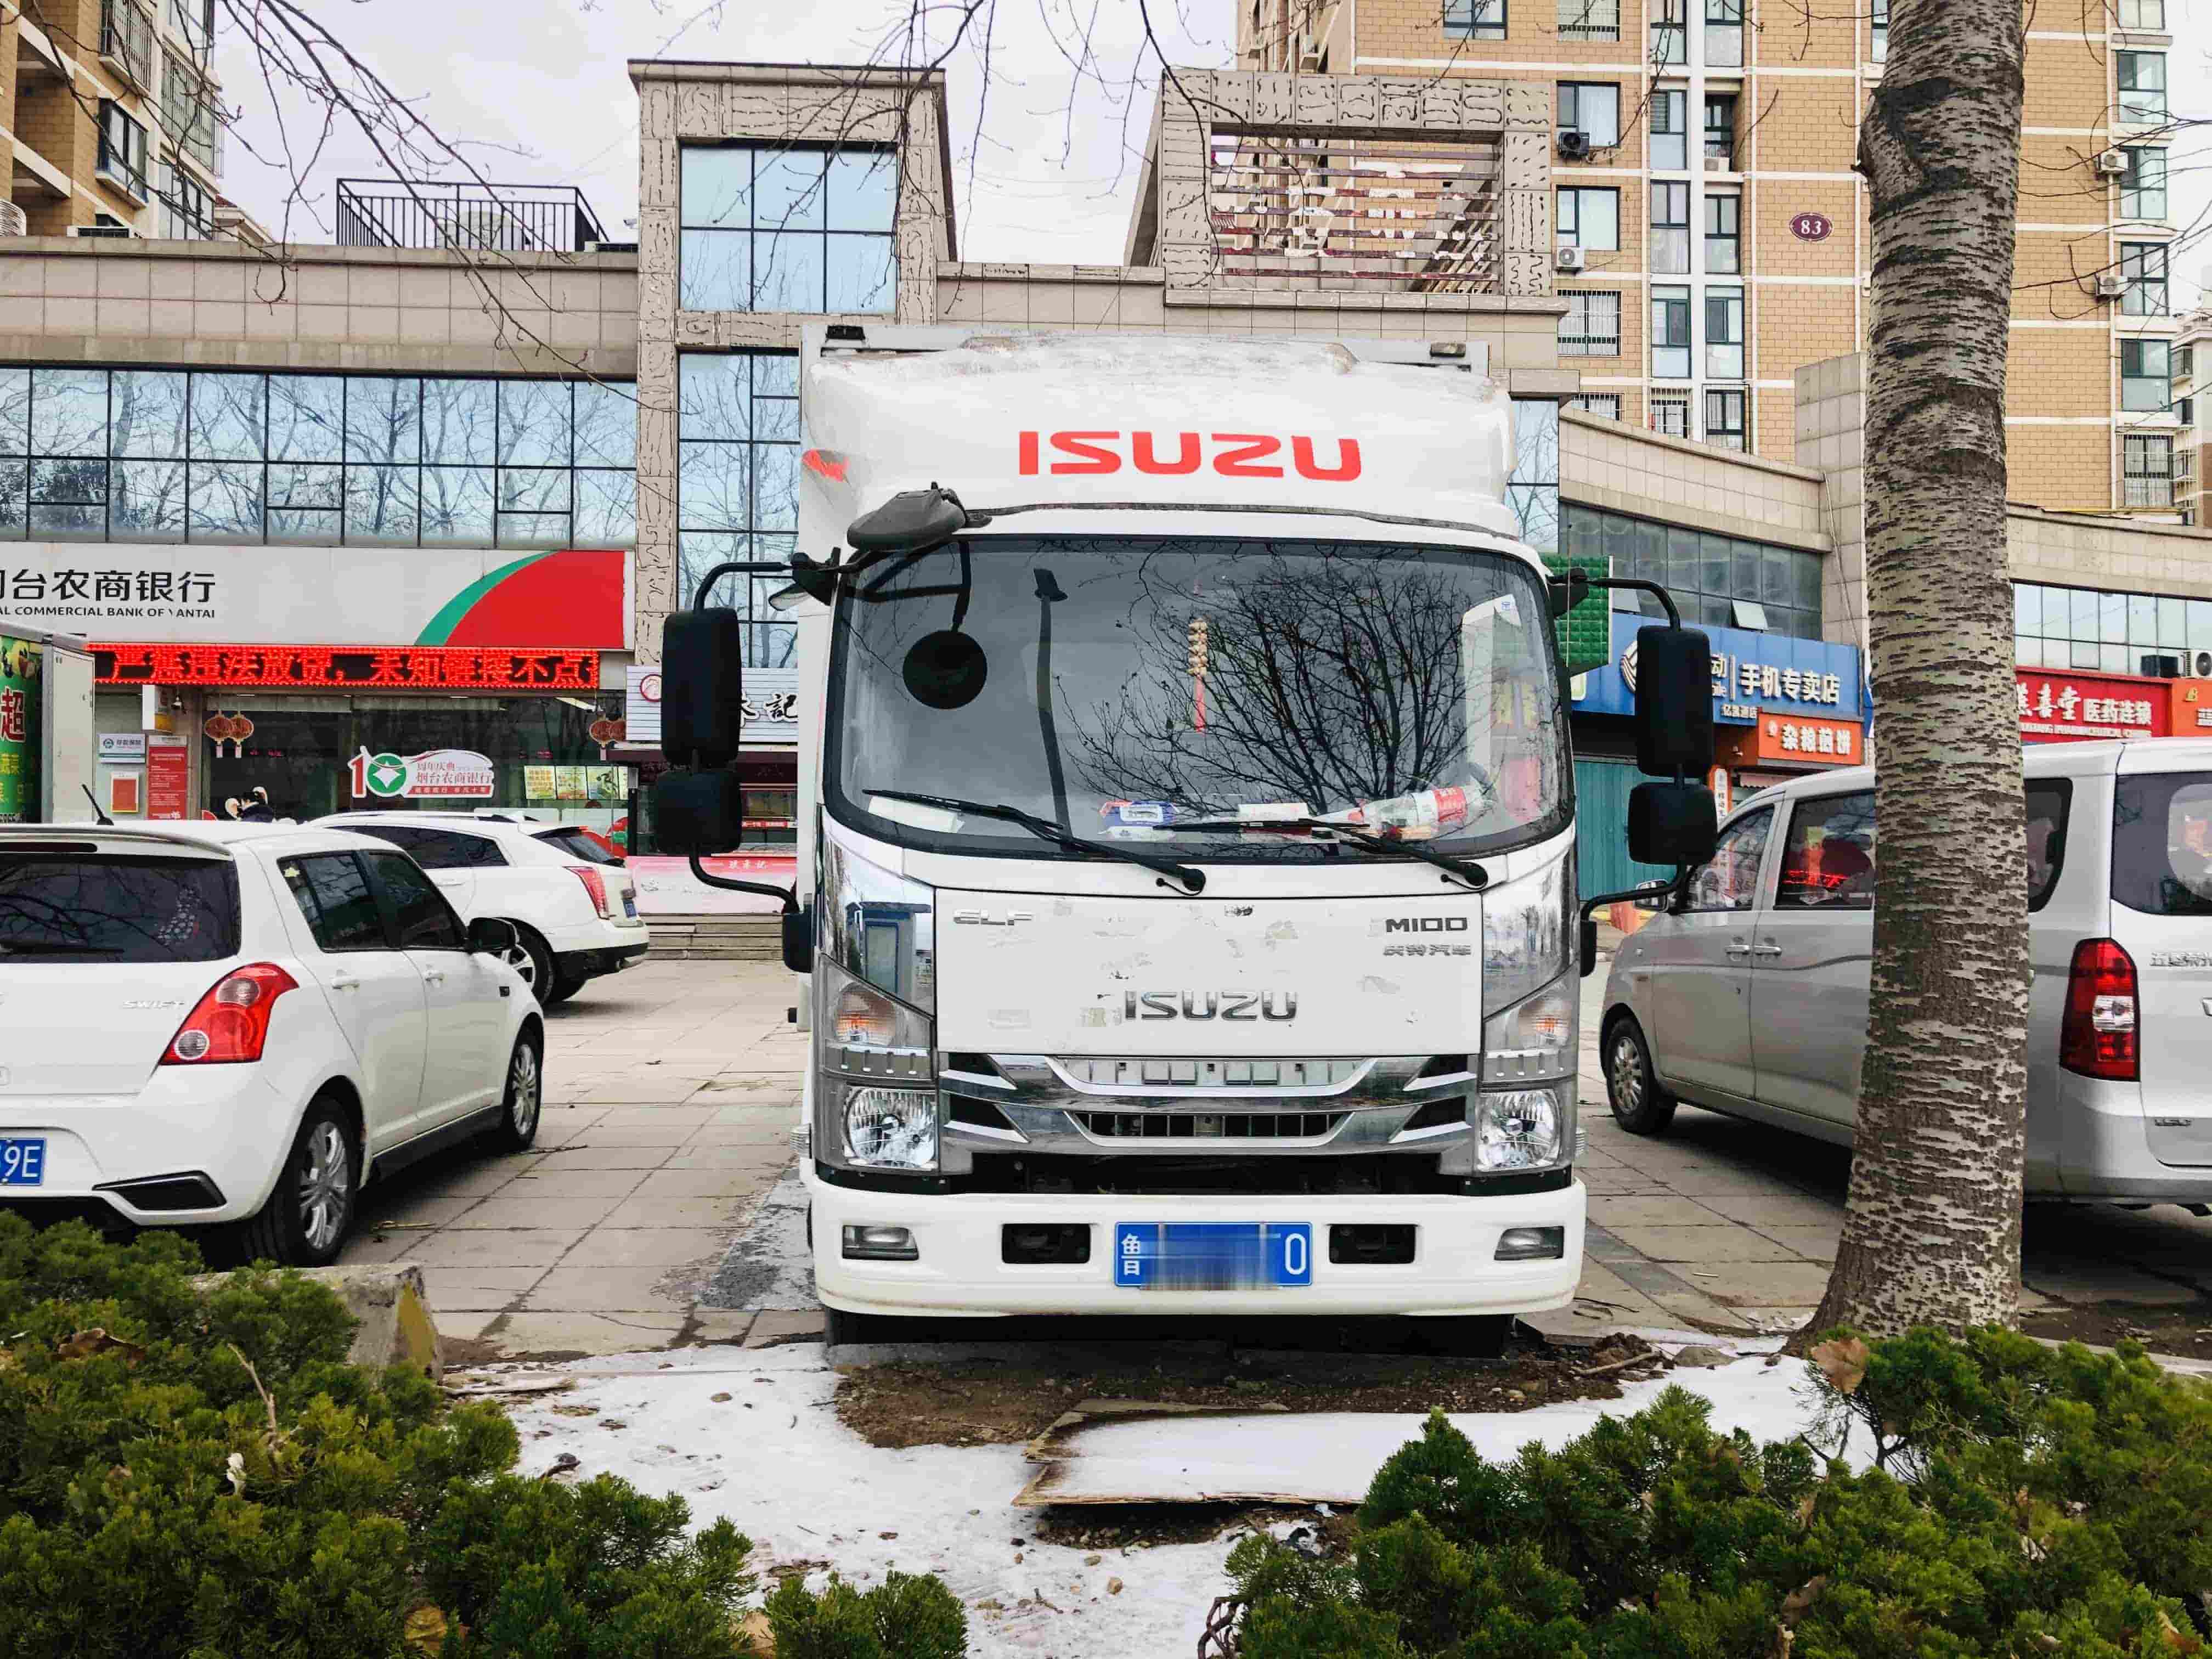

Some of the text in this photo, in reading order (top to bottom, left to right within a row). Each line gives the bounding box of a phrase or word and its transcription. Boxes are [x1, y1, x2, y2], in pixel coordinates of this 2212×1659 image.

[1801, 219, 1822, 235] 83
[1019, 431, 1362, 482] ISUZU
[0, 568, 216, 602] 台农商银行
[14, 606, 104, 617] COMMERCIAL
[108, 607, 144, 617] BANK
[147, 609, 166, 617] OF
[1740, 663, 1839, 703] 手机专卖店
[1385, 917, 1468, 933] M100
[1125, 990, 1297, 1022] ISUZU
